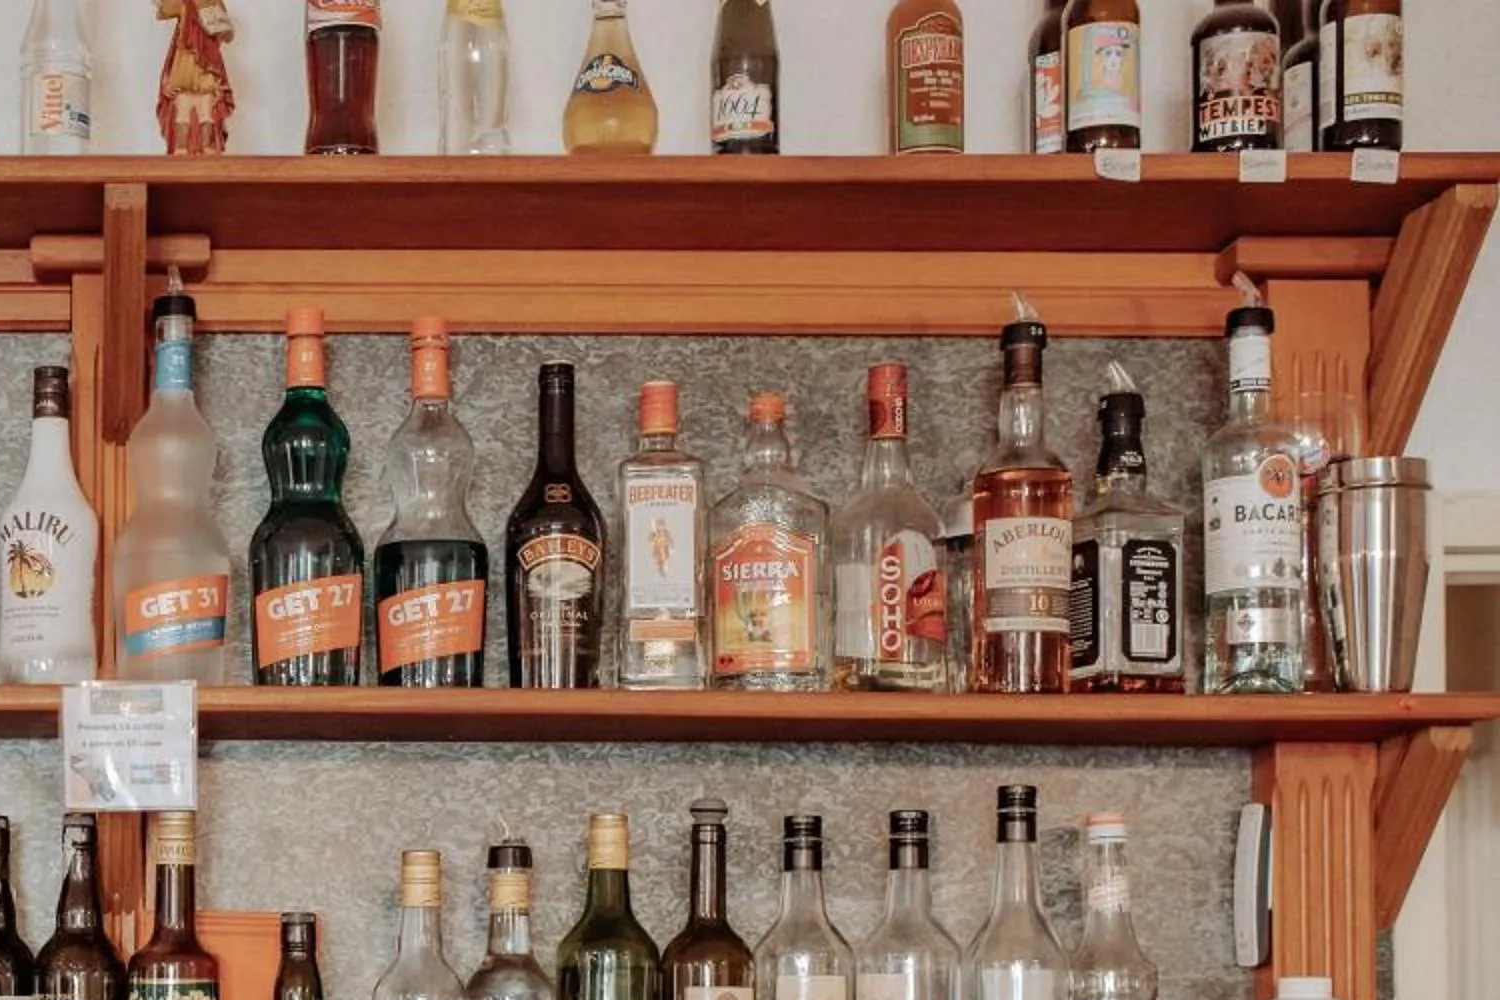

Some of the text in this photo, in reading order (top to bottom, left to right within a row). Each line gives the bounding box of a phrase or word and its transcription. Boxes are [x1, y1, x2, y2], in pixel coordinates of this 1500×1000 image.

[1199, 99, 1280, 122] TEMPEST
[1234, 503, 1301, 524] BACAR
[523, 536, 596, 563] BAILEYS
[722, 560, 799, 582] SIERRA
[140, 586, 219, 618] GET 31
[268, 583, 355, 618] GET 27
[388, 589, 475, 626] GET 27
[880, 555, 902, 652] SOHO
[530, 610, 589, 622] ORIINAL
